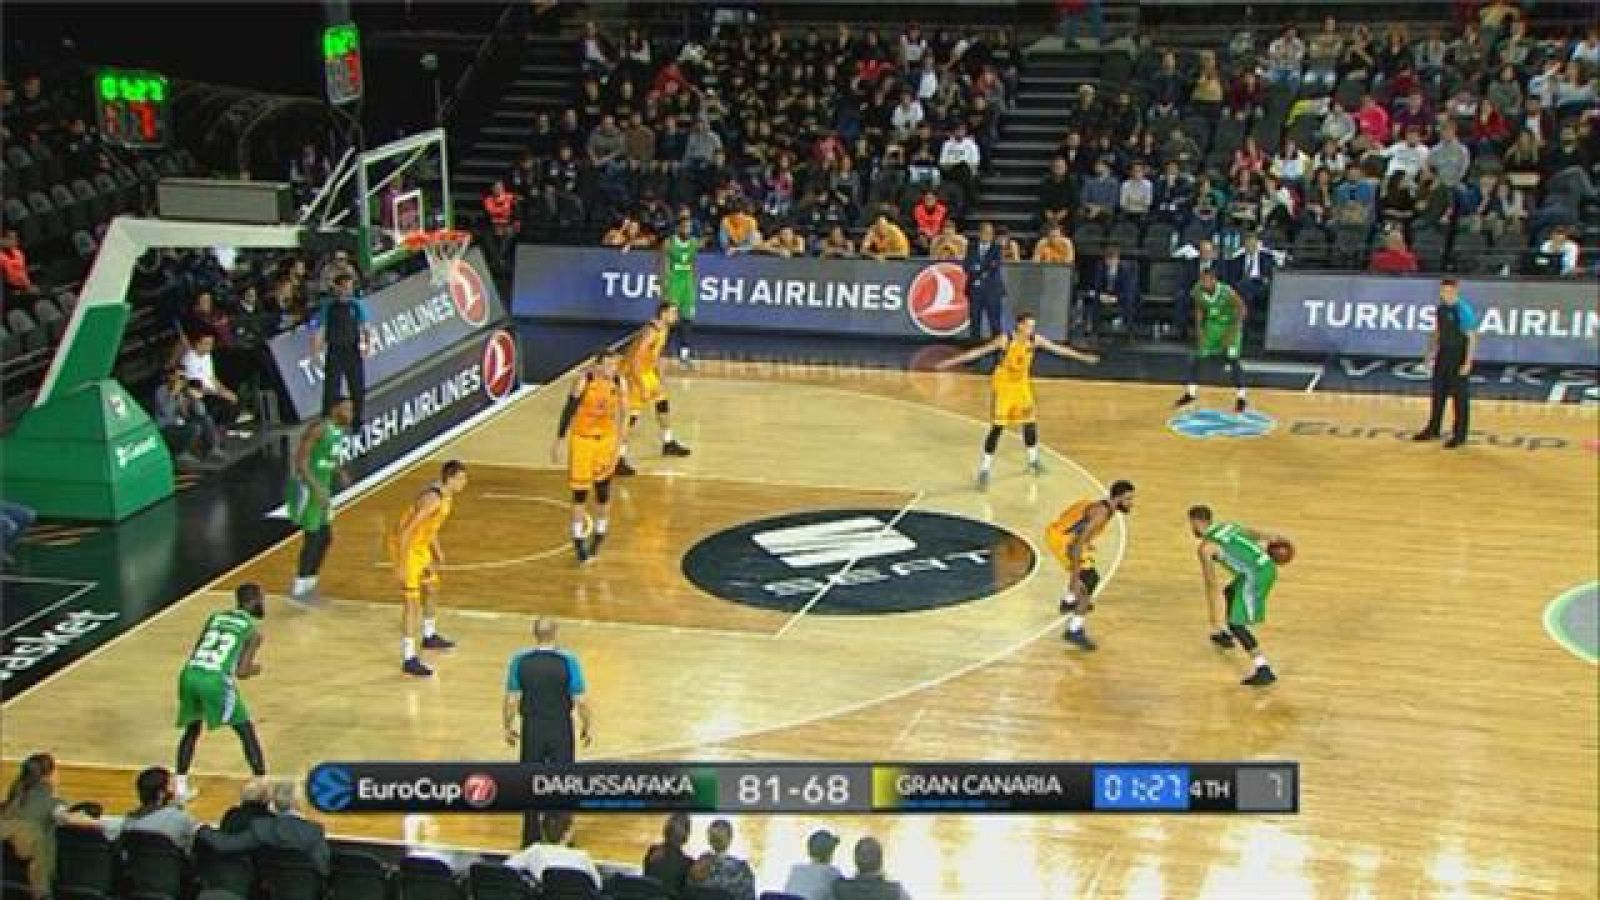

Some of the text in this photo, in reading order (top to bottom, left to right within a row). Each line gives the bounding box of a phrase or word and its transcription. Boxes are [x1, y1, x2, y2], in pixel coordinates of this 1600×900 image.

[602, 271, 902, 311] TURSH AIRLINES
[1303, 299, 1438, 331] TURKIS
[381, 291, 455, 348] AIRLINES
[338, 363, 481, 467] RKISH AIRLINES
